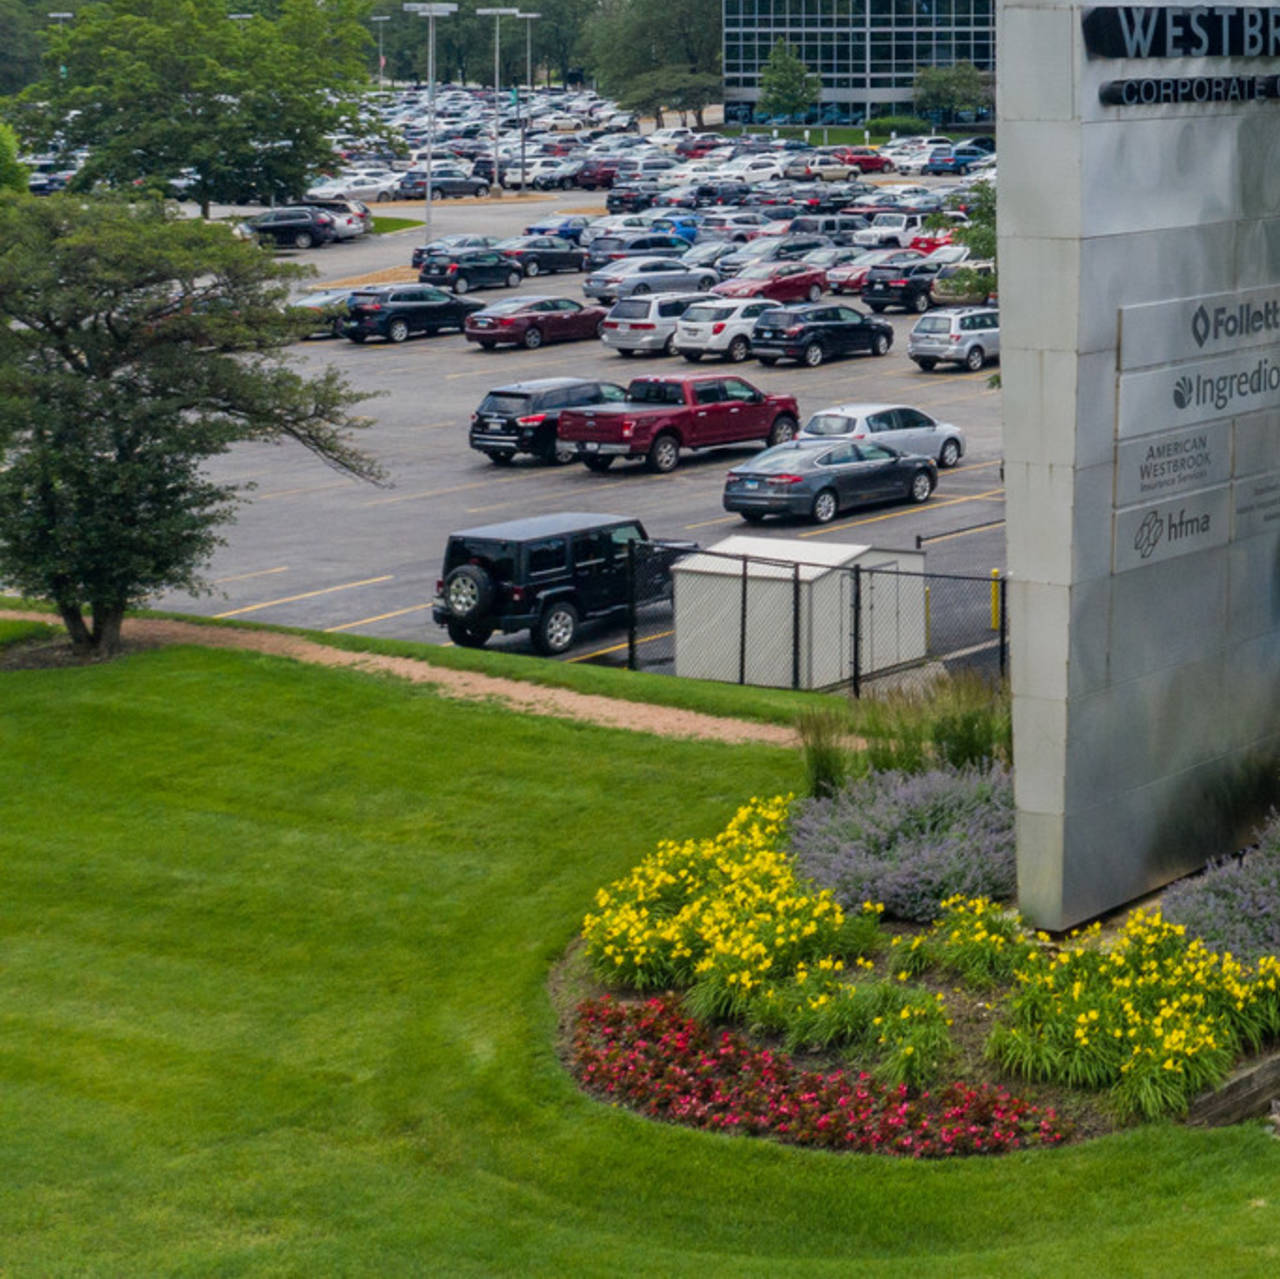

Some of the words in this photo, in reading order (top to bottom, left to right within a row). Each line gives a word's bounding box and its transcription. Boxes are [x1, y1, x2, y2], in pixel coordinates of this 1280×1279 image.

[1121, 75, 1267, 105] CORPORATE
[1213, 300, 1280, 340] Follett
[1146, 436, 1208, 462] AMERICAN
[1140, 451, 1212, 481] WESTBROOK
[1168, 509, 1211, 542] hfma
